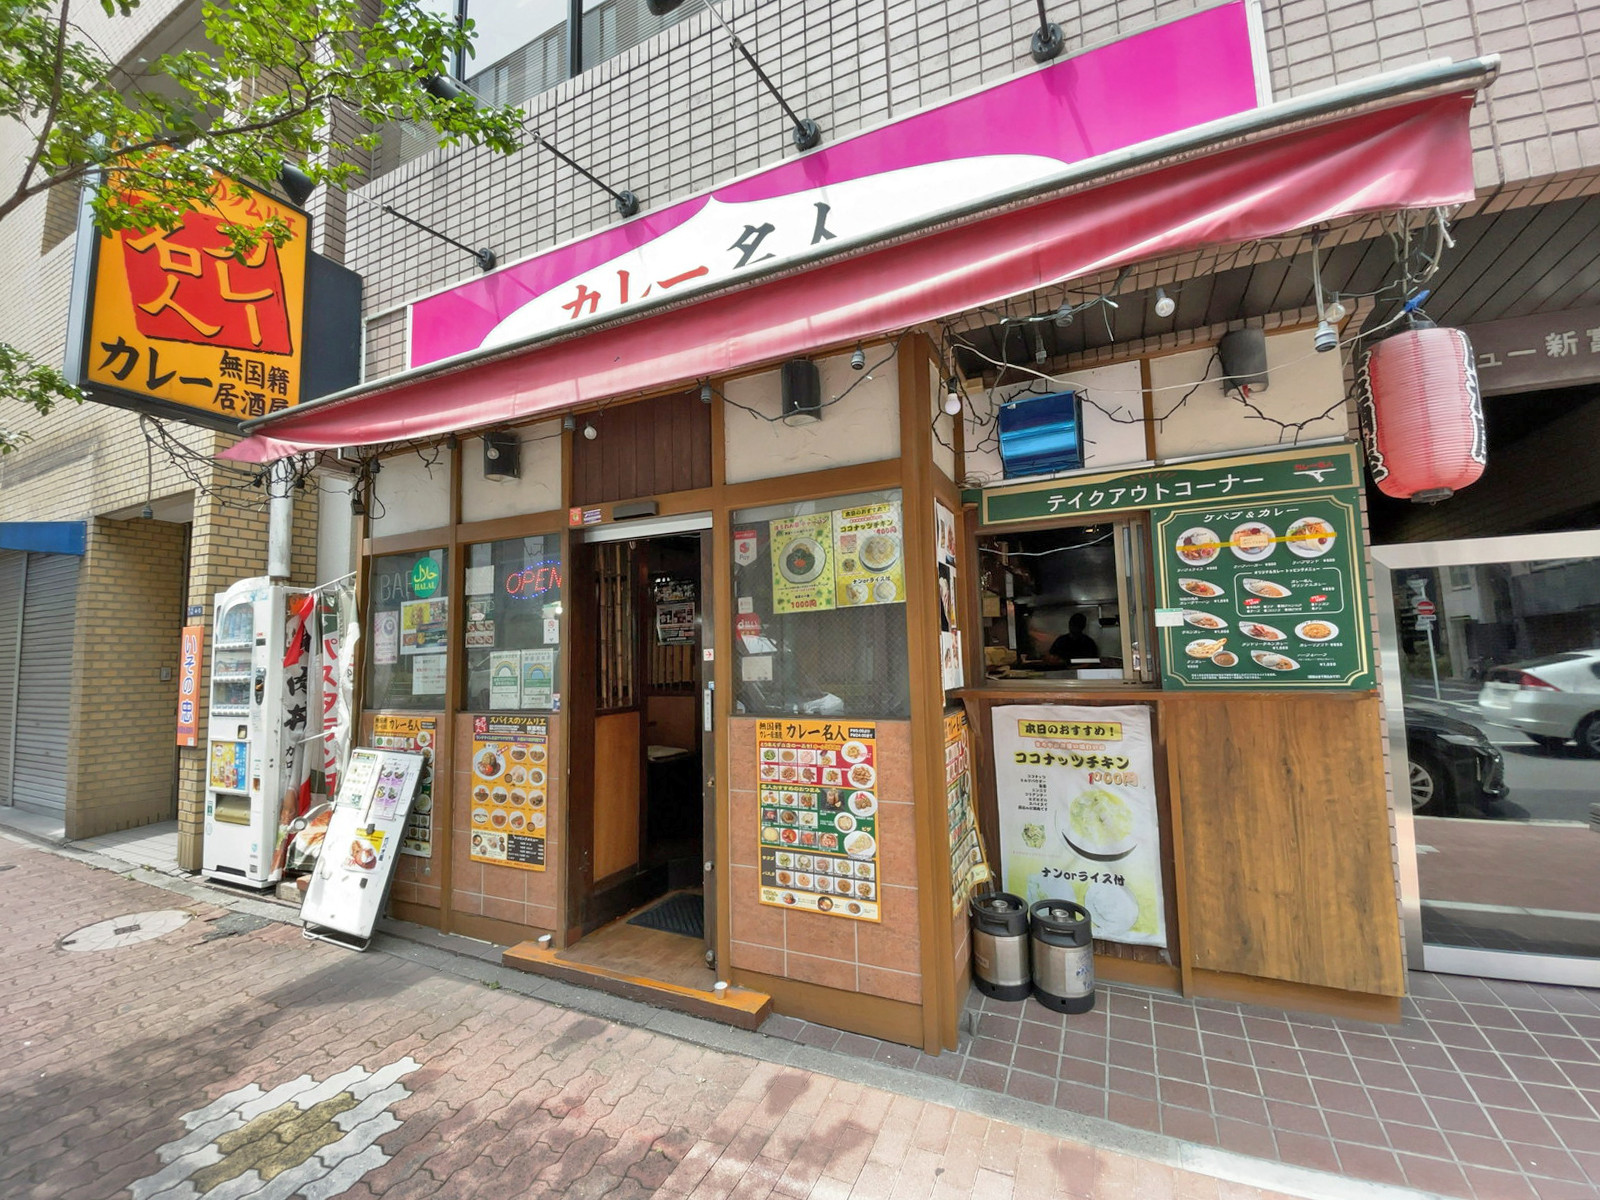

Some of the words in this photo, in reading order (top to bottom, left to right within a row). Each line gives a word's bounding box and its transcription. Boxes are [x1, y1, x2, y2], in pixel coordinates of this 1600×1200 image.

[98, 336, 213, 390] カレー
[219, 351, 290, 396] 無国籍
[1047, 473, 1264, 512] テイクアウトコーナー
[414, 582, 436, 591] HALAL
[506, 567, 561, 594] OPEN
[490, 716, 546, 726] スパイスのソムリエ
[1025, 723, 1114, 737] 本日のおすすめ！
[787, 724, 847, 741] カレー名人
[1016, 752, 1129, 770] ココナッツチキン
[1042, 867, 1125, 886] ナンorライス付
